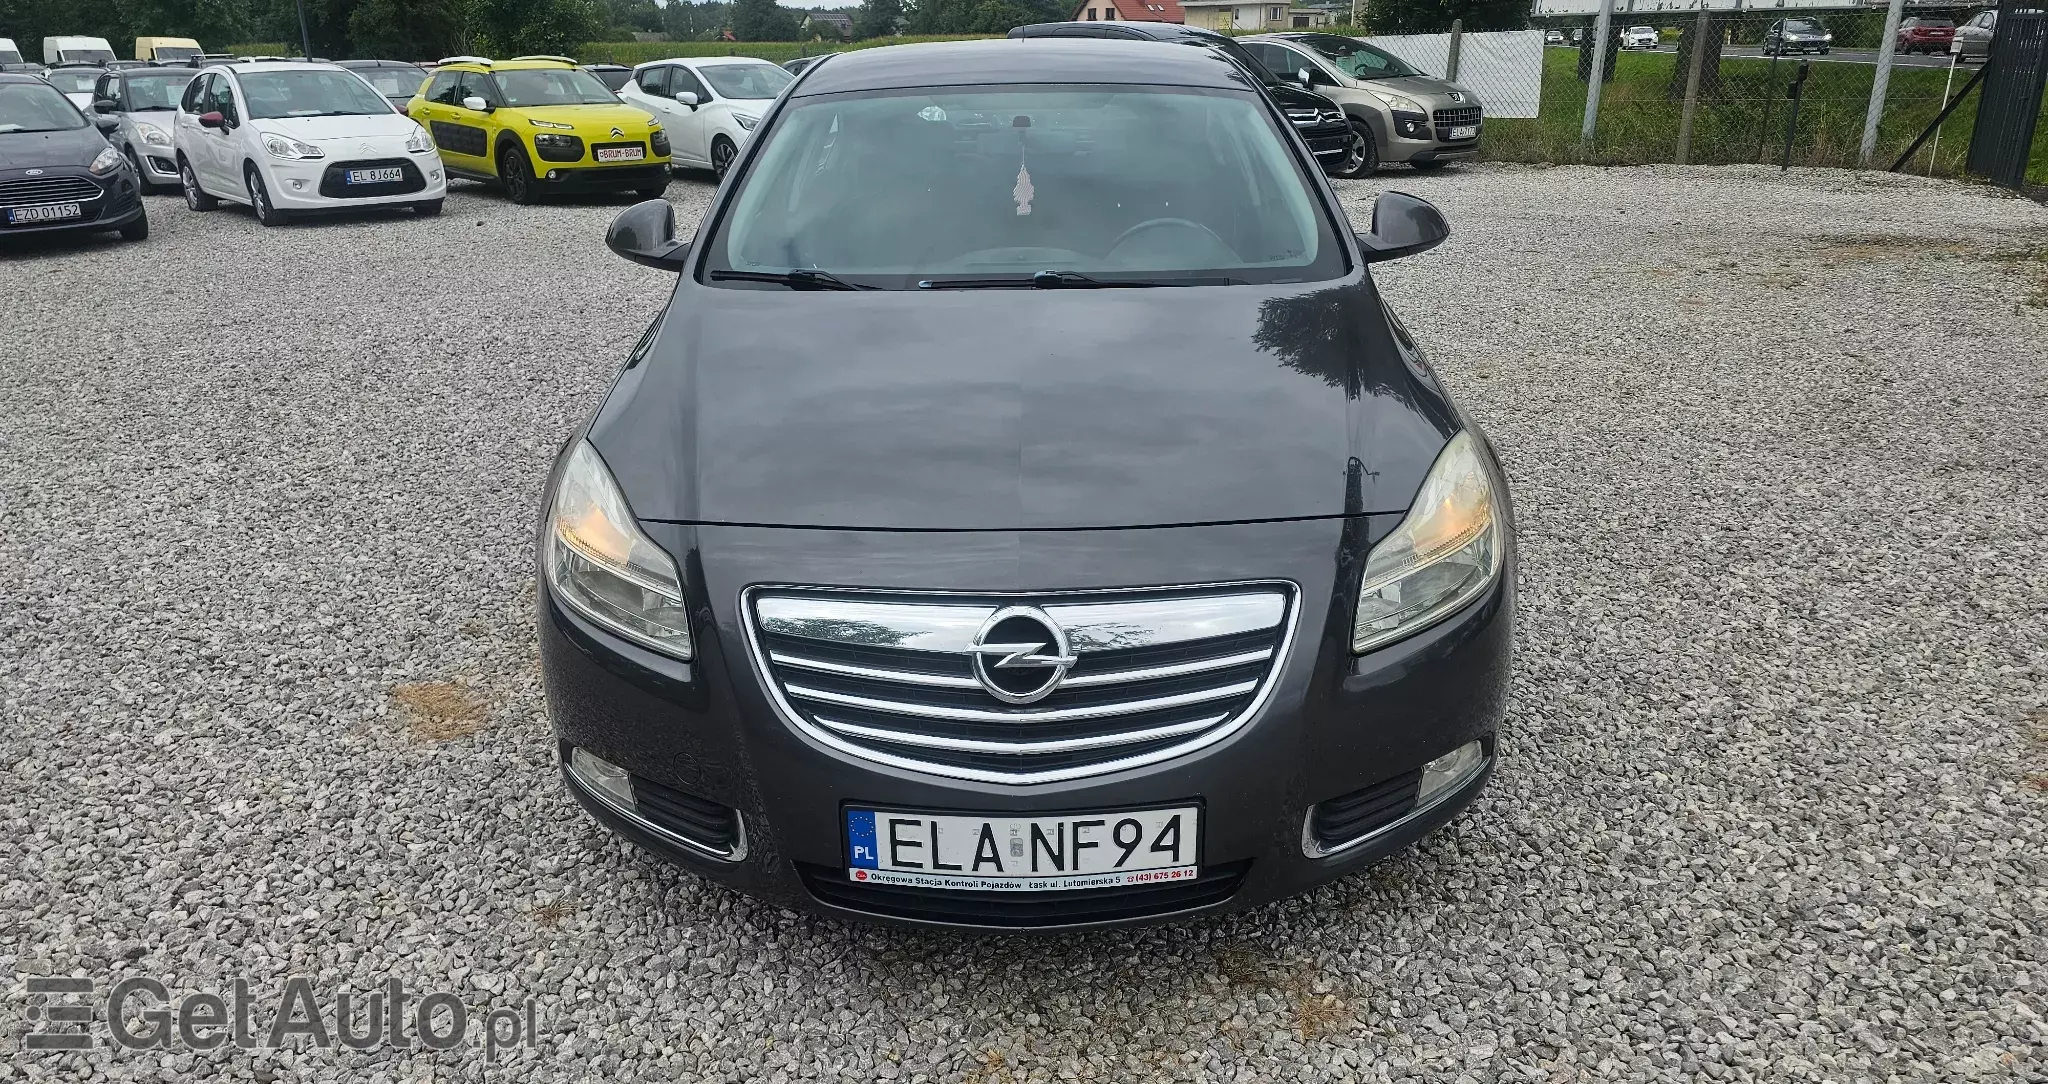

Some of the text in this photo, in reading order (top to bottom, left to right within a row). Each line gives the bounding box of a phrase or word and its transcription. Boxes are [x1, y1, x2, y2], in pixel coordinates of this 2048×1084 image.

[353, 169, 400, 181] EL 8J664
[14, 209, 38, 221] EZD
[42, 205, 79, 217] 01152
[889, 815, 1181, 872] ELA NF94
[854, 846, 874, 860] PL
[871, 873, 912, 884] Okręgowa
[915, 878, 942, 886] Stacja
[945, 879, 978, 888] Kontroli
[981, 881, 1022, 889] Pojazdów
[1050, 879, 1060, 888] ul.
[1063, 877, 1113, 887] Lutomierska
[1136, 872, 1151, 882] (43)
